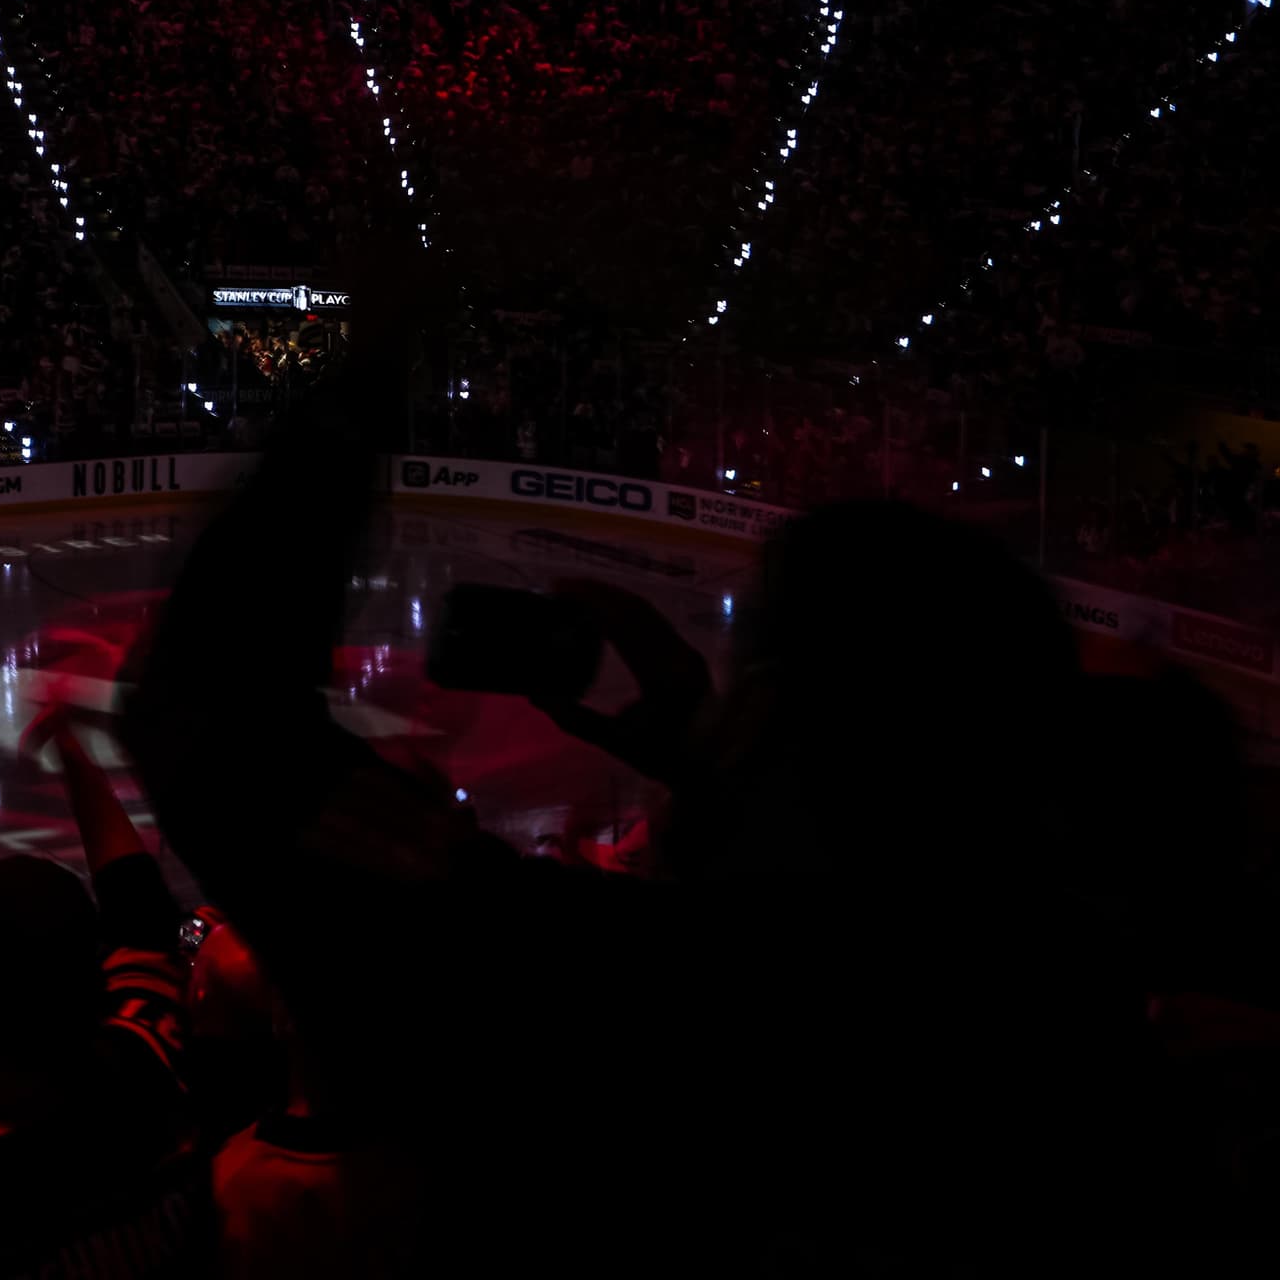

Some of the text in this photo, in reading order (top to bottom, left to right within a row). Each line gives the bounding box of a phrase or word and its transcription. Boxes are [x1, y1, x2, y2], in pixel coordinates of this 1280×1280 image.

[213, 290, 266, 302] STANLEY
[269, 292, 291, 303] CUP
[73, 458, 180, 496] NOBULL
[511, 470, 651, 512] GEICO
